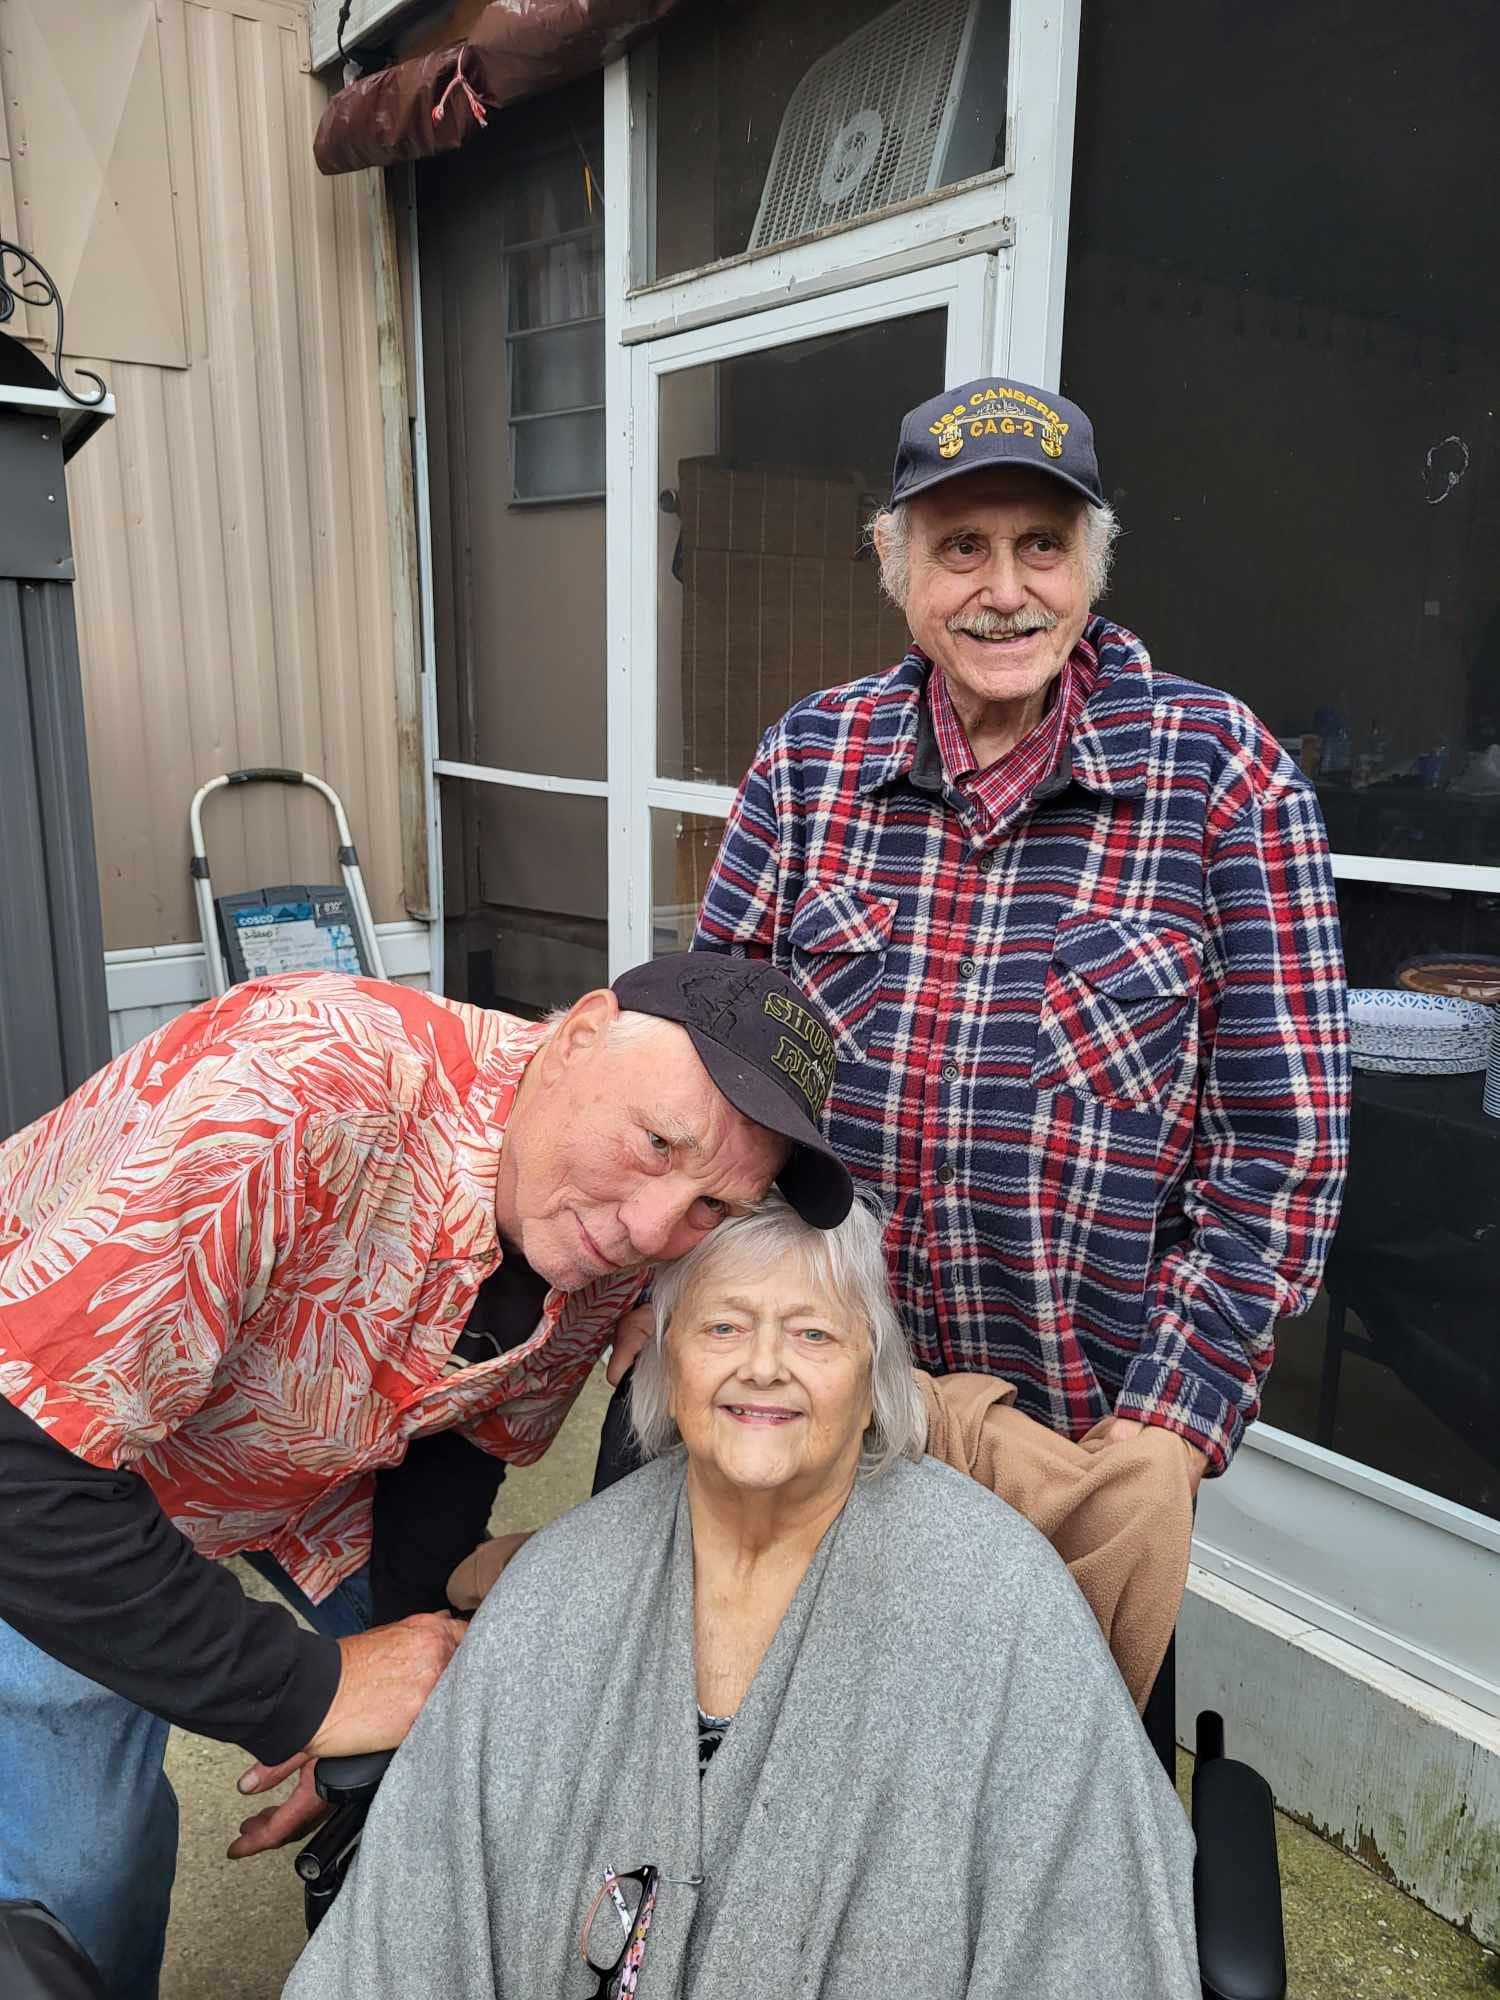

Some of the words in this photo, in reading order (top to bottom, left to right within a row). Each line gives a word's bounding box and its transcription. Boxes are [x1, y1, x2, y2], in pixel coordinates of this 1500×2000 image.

[929, 405, 966, 435] USS
[970, 388, 1069, 436] CANBERRA
[969, 417, 1035, 438] CAG-2
